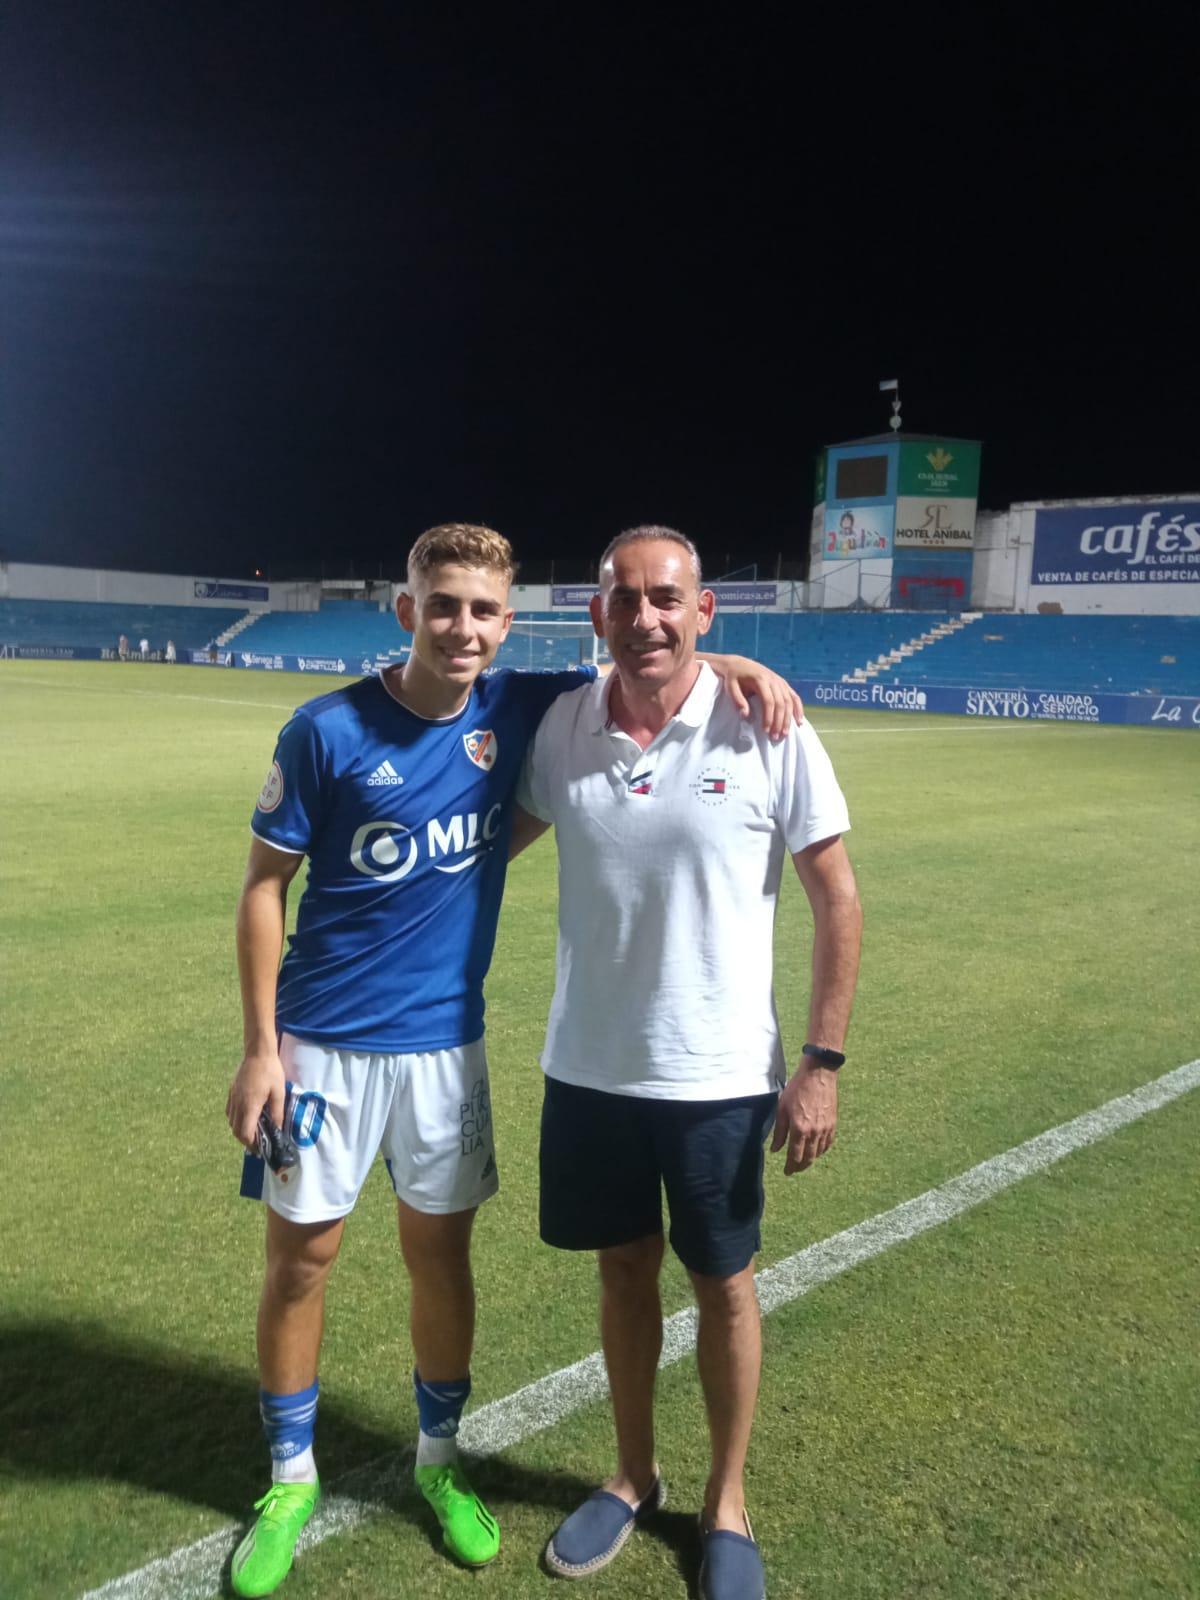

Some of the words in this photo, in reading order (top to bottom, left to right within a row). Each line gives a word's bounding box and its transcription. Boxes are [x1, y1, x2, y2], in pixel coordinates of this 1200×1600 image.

[896, 528, 931, 539] HOTEL
[1079, 511, 1200, 565] cafés
[1145, 555, 1157, 564] EL
[1159, 553, 1185, 564] CAFÉ
[1187, 553, 1200, 564] DE
[1038, 571, 1072, 582] VENTA
[1075, 571, 1089, 582] DE
[1092, 568, 1128, 581] CAFÉS
[1131, 570, 1146, 581] DE
[1149, 569, 1200, 580] ESPECIA
[815, 684, 869, 703] ópticas
[1039, 693, 1093, 706] CALIDAD
[966, 699, 1030, 718] SIXTO
[1031, 702, 1040, 713] Y
[1042, 702, 1099, 716] SERVICIO
[1151, 698, 1182, 722] La
[366, 776, 404, 786] adidas
[427, 803, 502, 858] MLC
